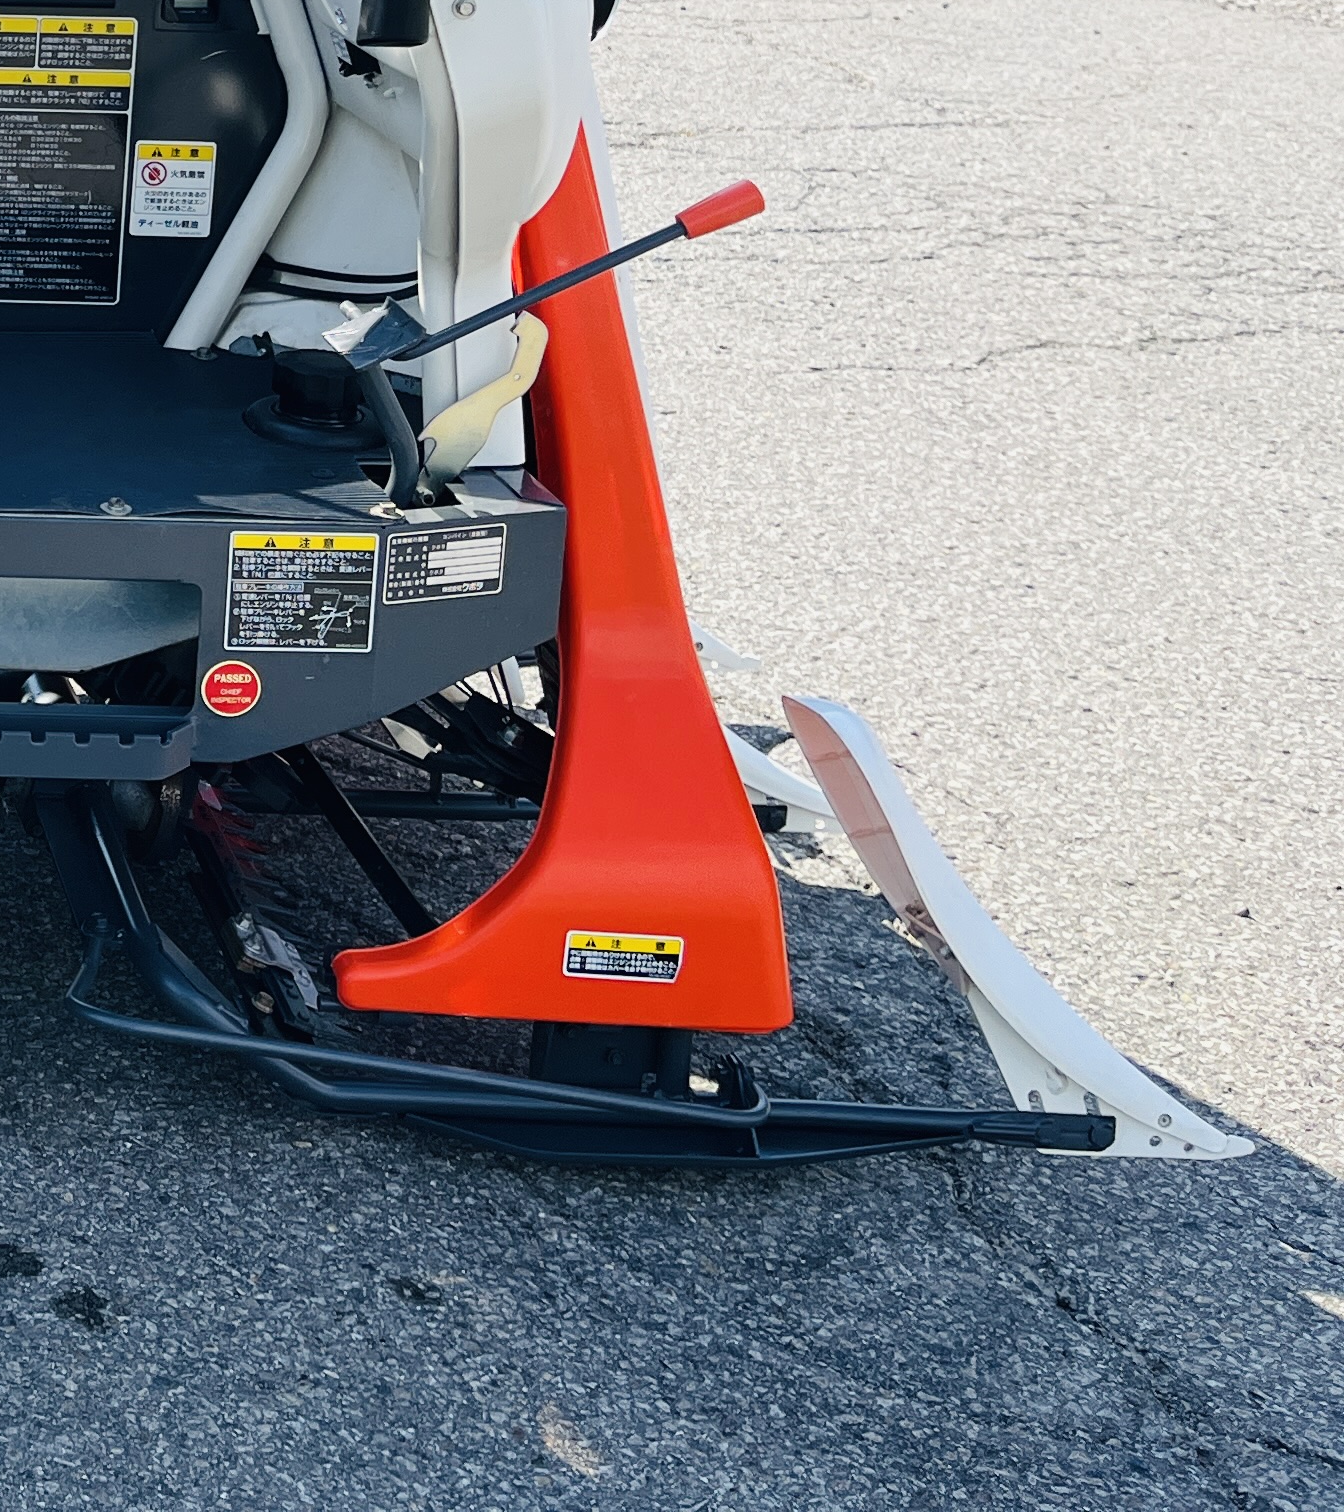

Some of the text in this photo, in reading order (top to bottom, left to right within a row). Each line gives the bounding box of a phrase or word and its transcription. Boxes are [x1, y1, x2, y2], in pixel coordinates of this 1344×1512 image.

[170, 148, 200, 158] 注意
[170, 170, 206, 179] 火気厳禁
[138, 219, 199, 229] ディーゼル軽油
[299, 537, 334, 549] 注意
[213, 673, 252, 684] PASSED
